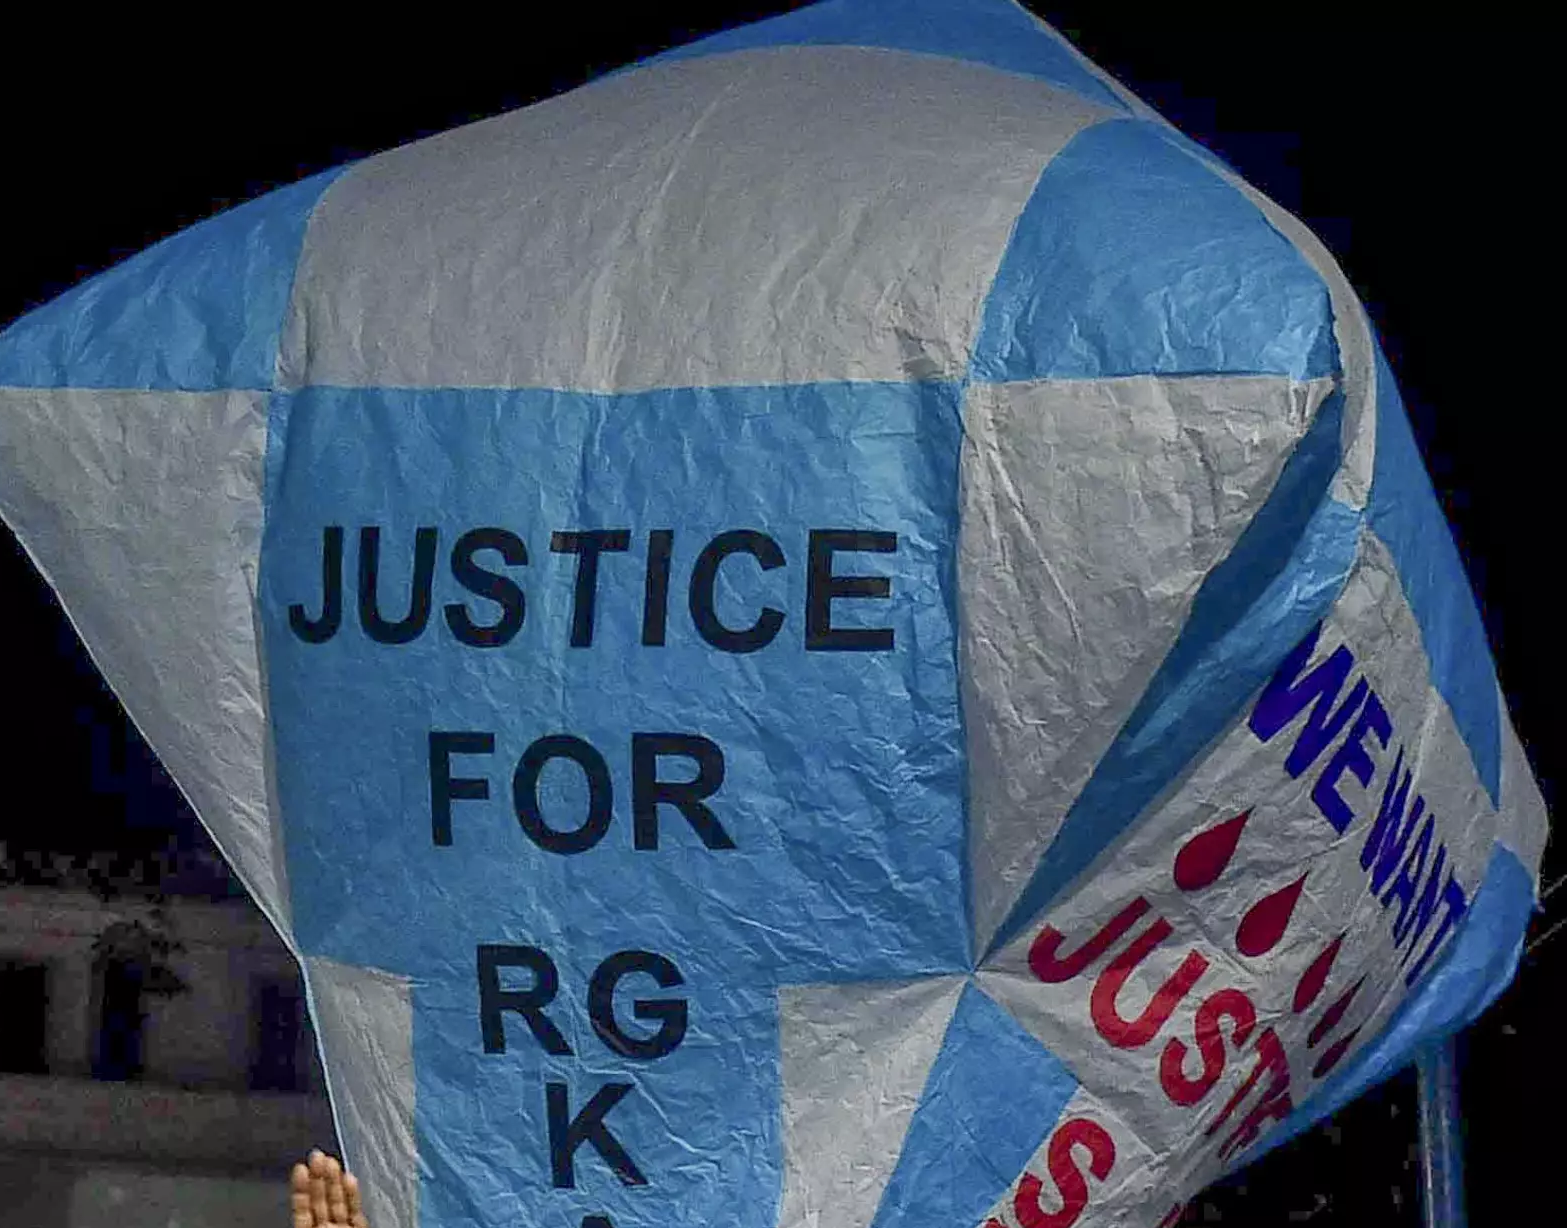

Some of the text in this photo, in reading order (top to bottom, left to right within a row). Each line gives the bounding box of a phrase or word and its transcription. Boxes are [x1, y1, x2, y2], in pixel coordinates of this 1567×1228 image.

[288, 525, 898, 653] JUSTICE
[428, 731, 737, 855] FOR
[1246, 616, 1469, 988] WE WANT
[476, 943, 688, 1060] RG
